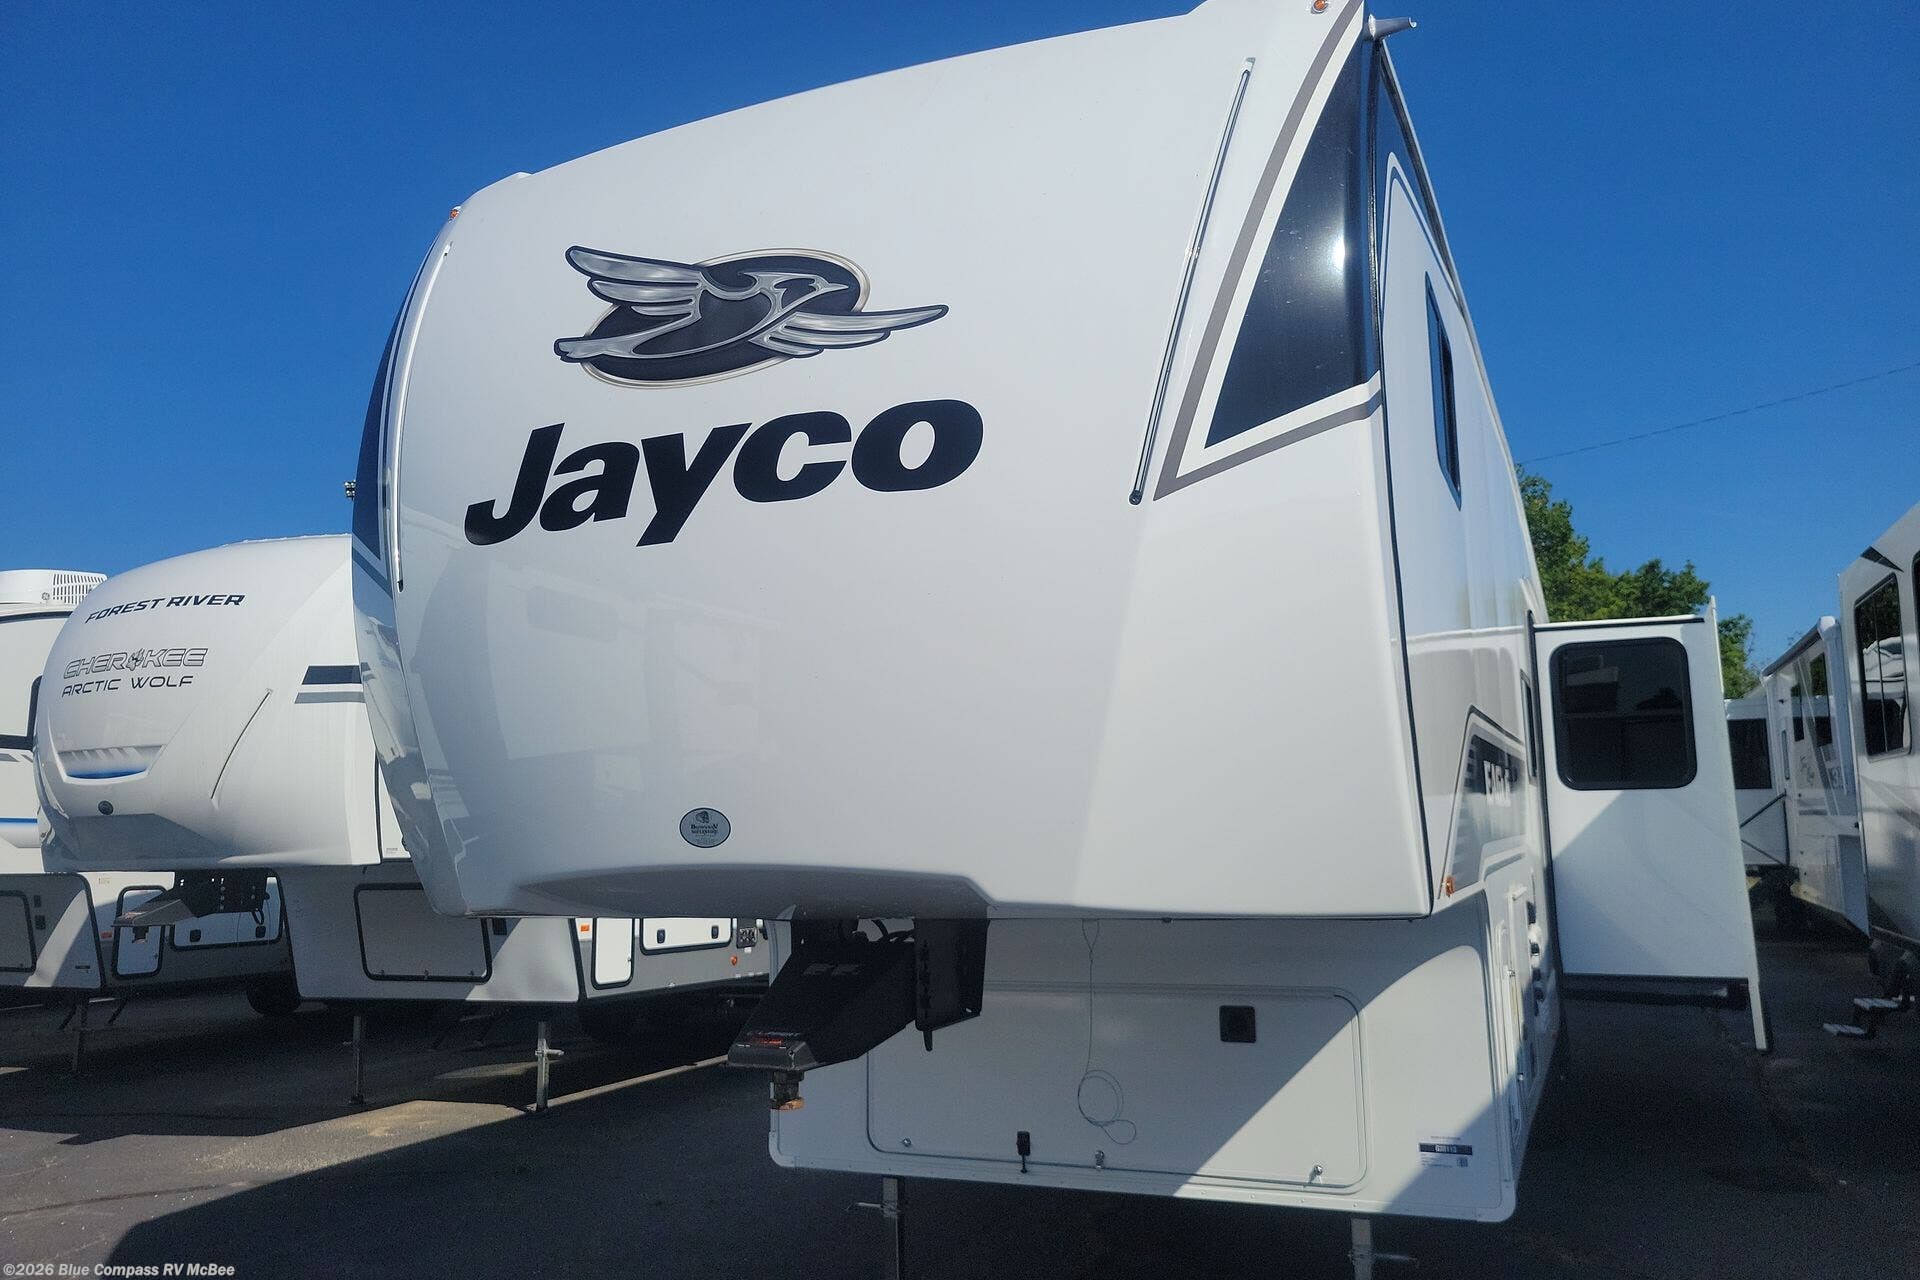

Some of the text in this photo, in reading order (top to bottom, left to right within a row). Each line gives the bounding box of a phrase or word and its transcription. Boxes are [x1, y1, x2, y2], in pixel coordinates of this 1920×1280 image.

[464, 398, 984, 547] Jayco
[85, 594, 246, 624] FOREST RIVER
[62, 675, 194, 698] ARCTIC WOLF
